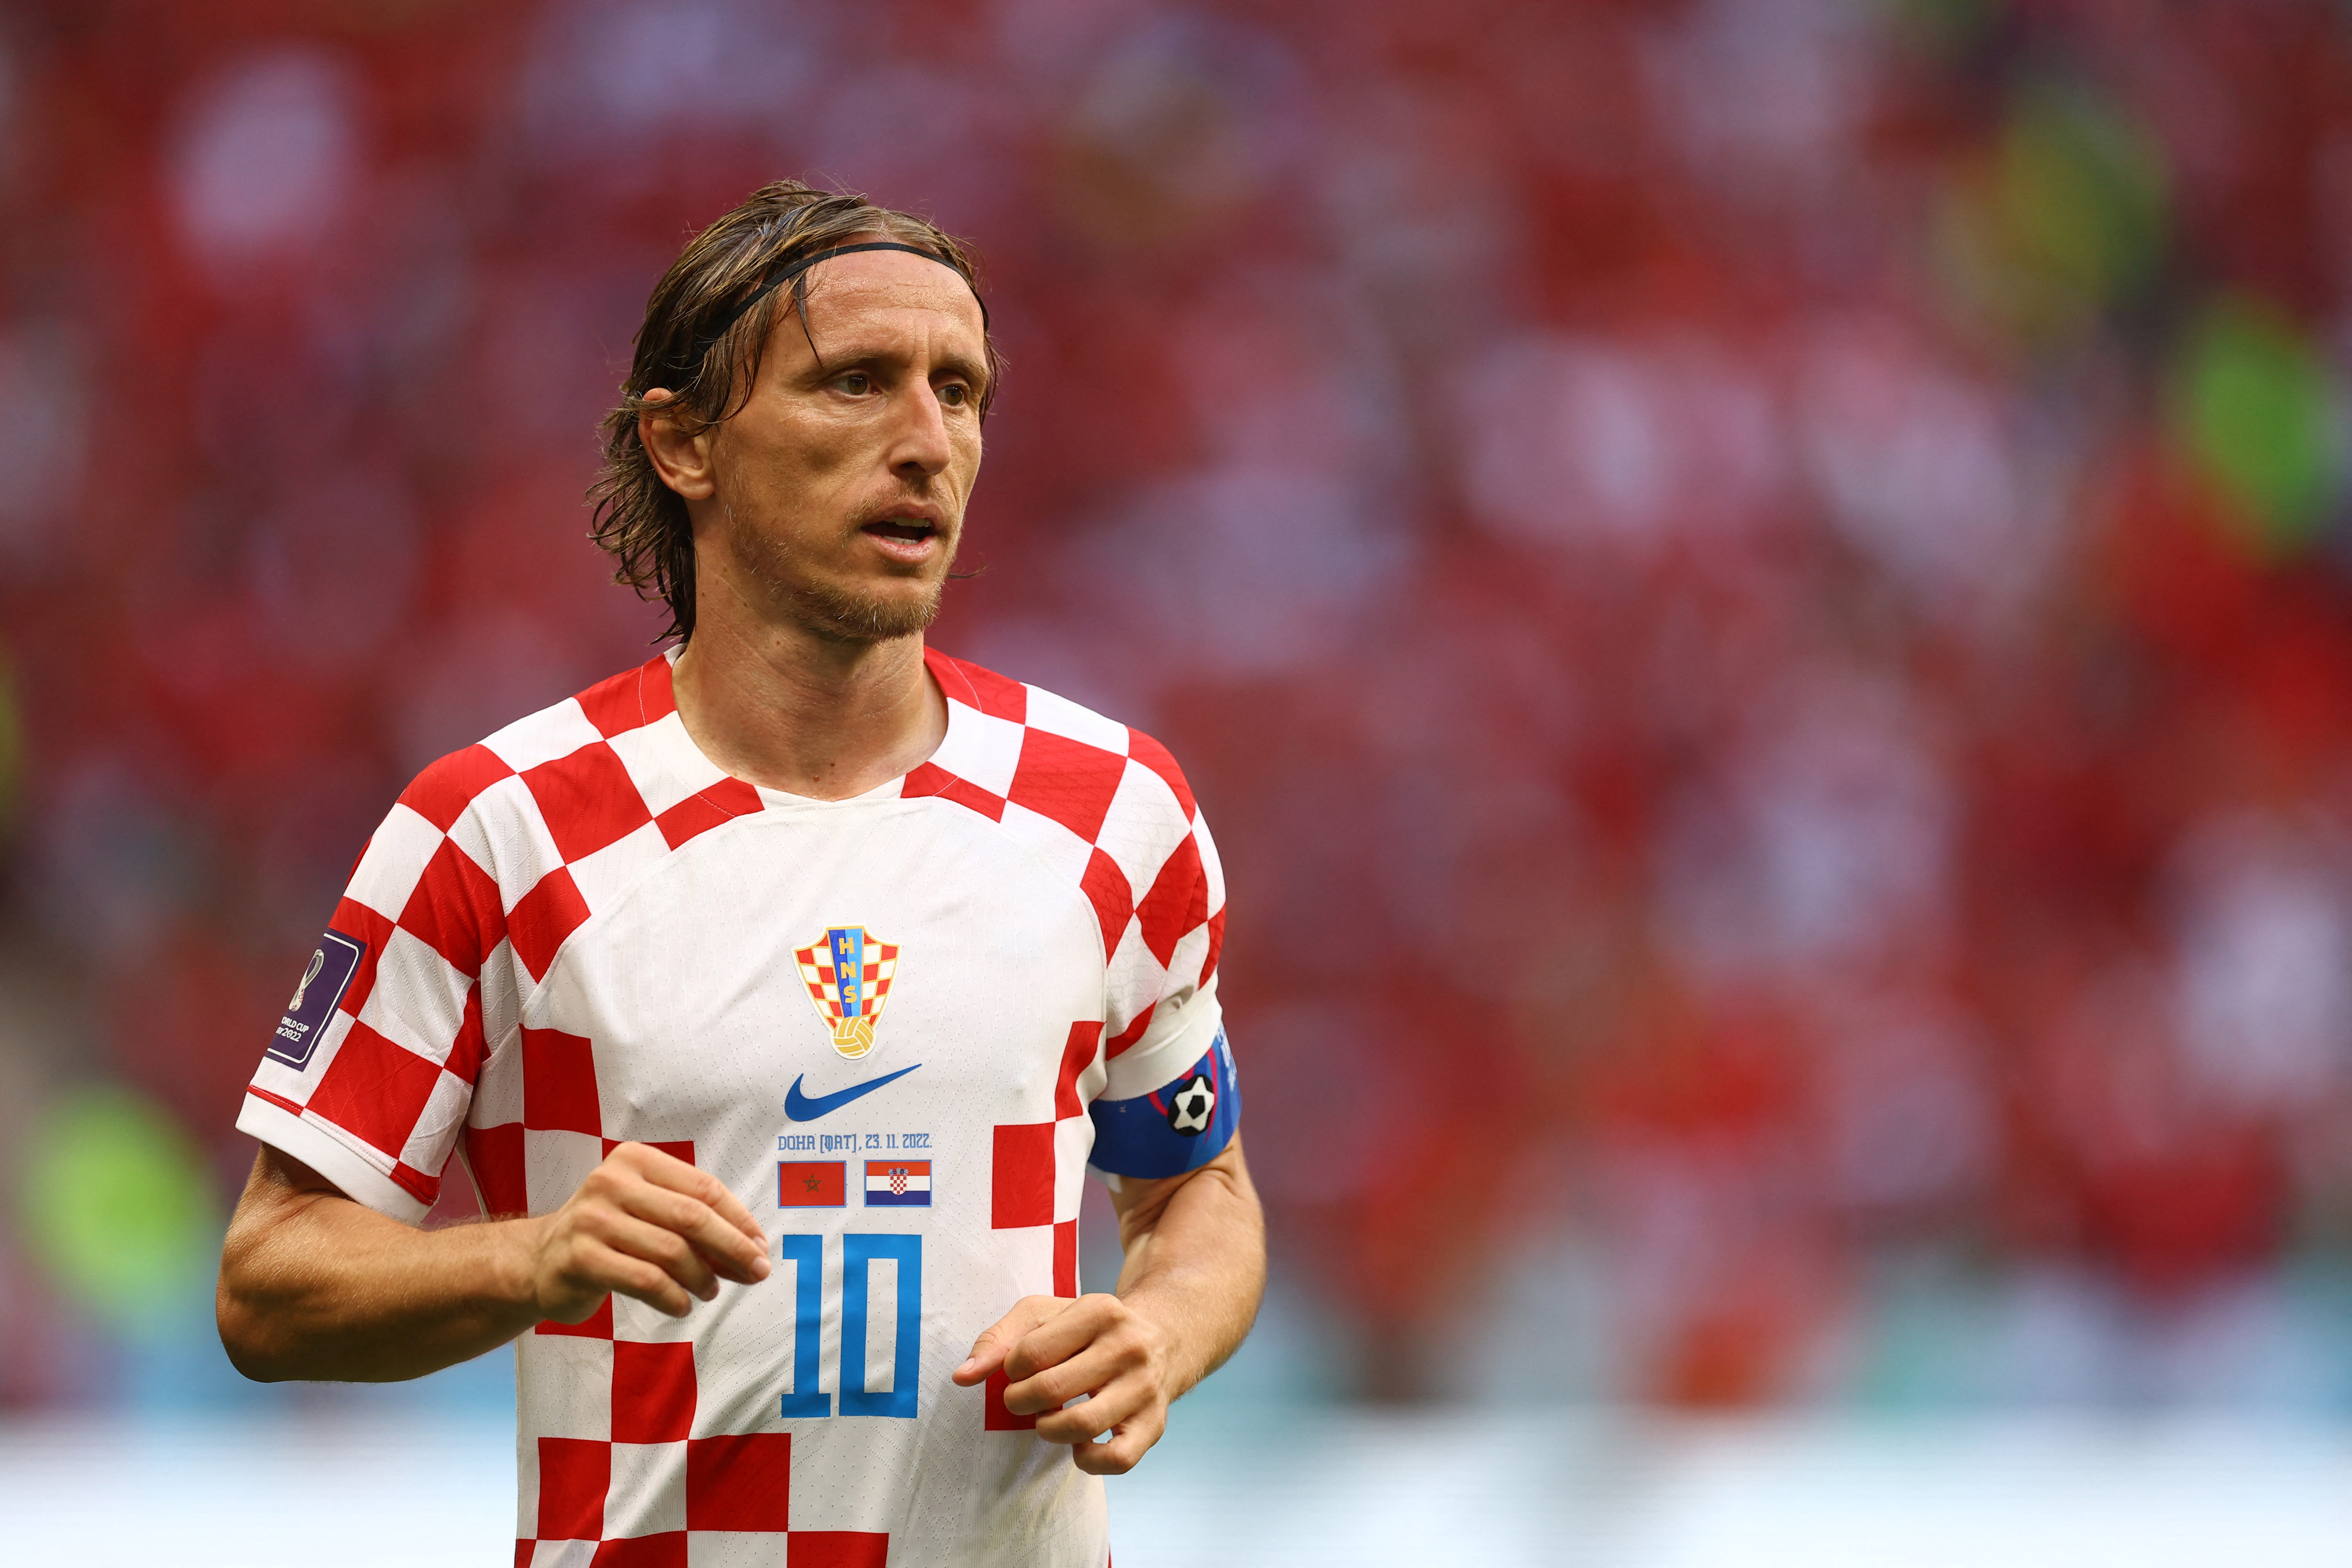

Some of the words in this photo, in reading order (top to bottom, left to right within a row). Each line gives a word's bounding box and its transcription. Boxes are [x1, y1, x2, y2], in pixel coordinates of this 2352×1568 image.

[838, 937, 858, 1004] HNS
[281, 1016, 297, 1028] ORLD
[296, 1023, 309, 1033] CUP
[778, 1135, 815, 1150] DOHA
[866, 1134, 882, 1149] 23.
[886, 1134, 899, 1149] 11.
[903, 1133, 932, 1149] 2022.
[782, 1234, 922, 1418] 10
